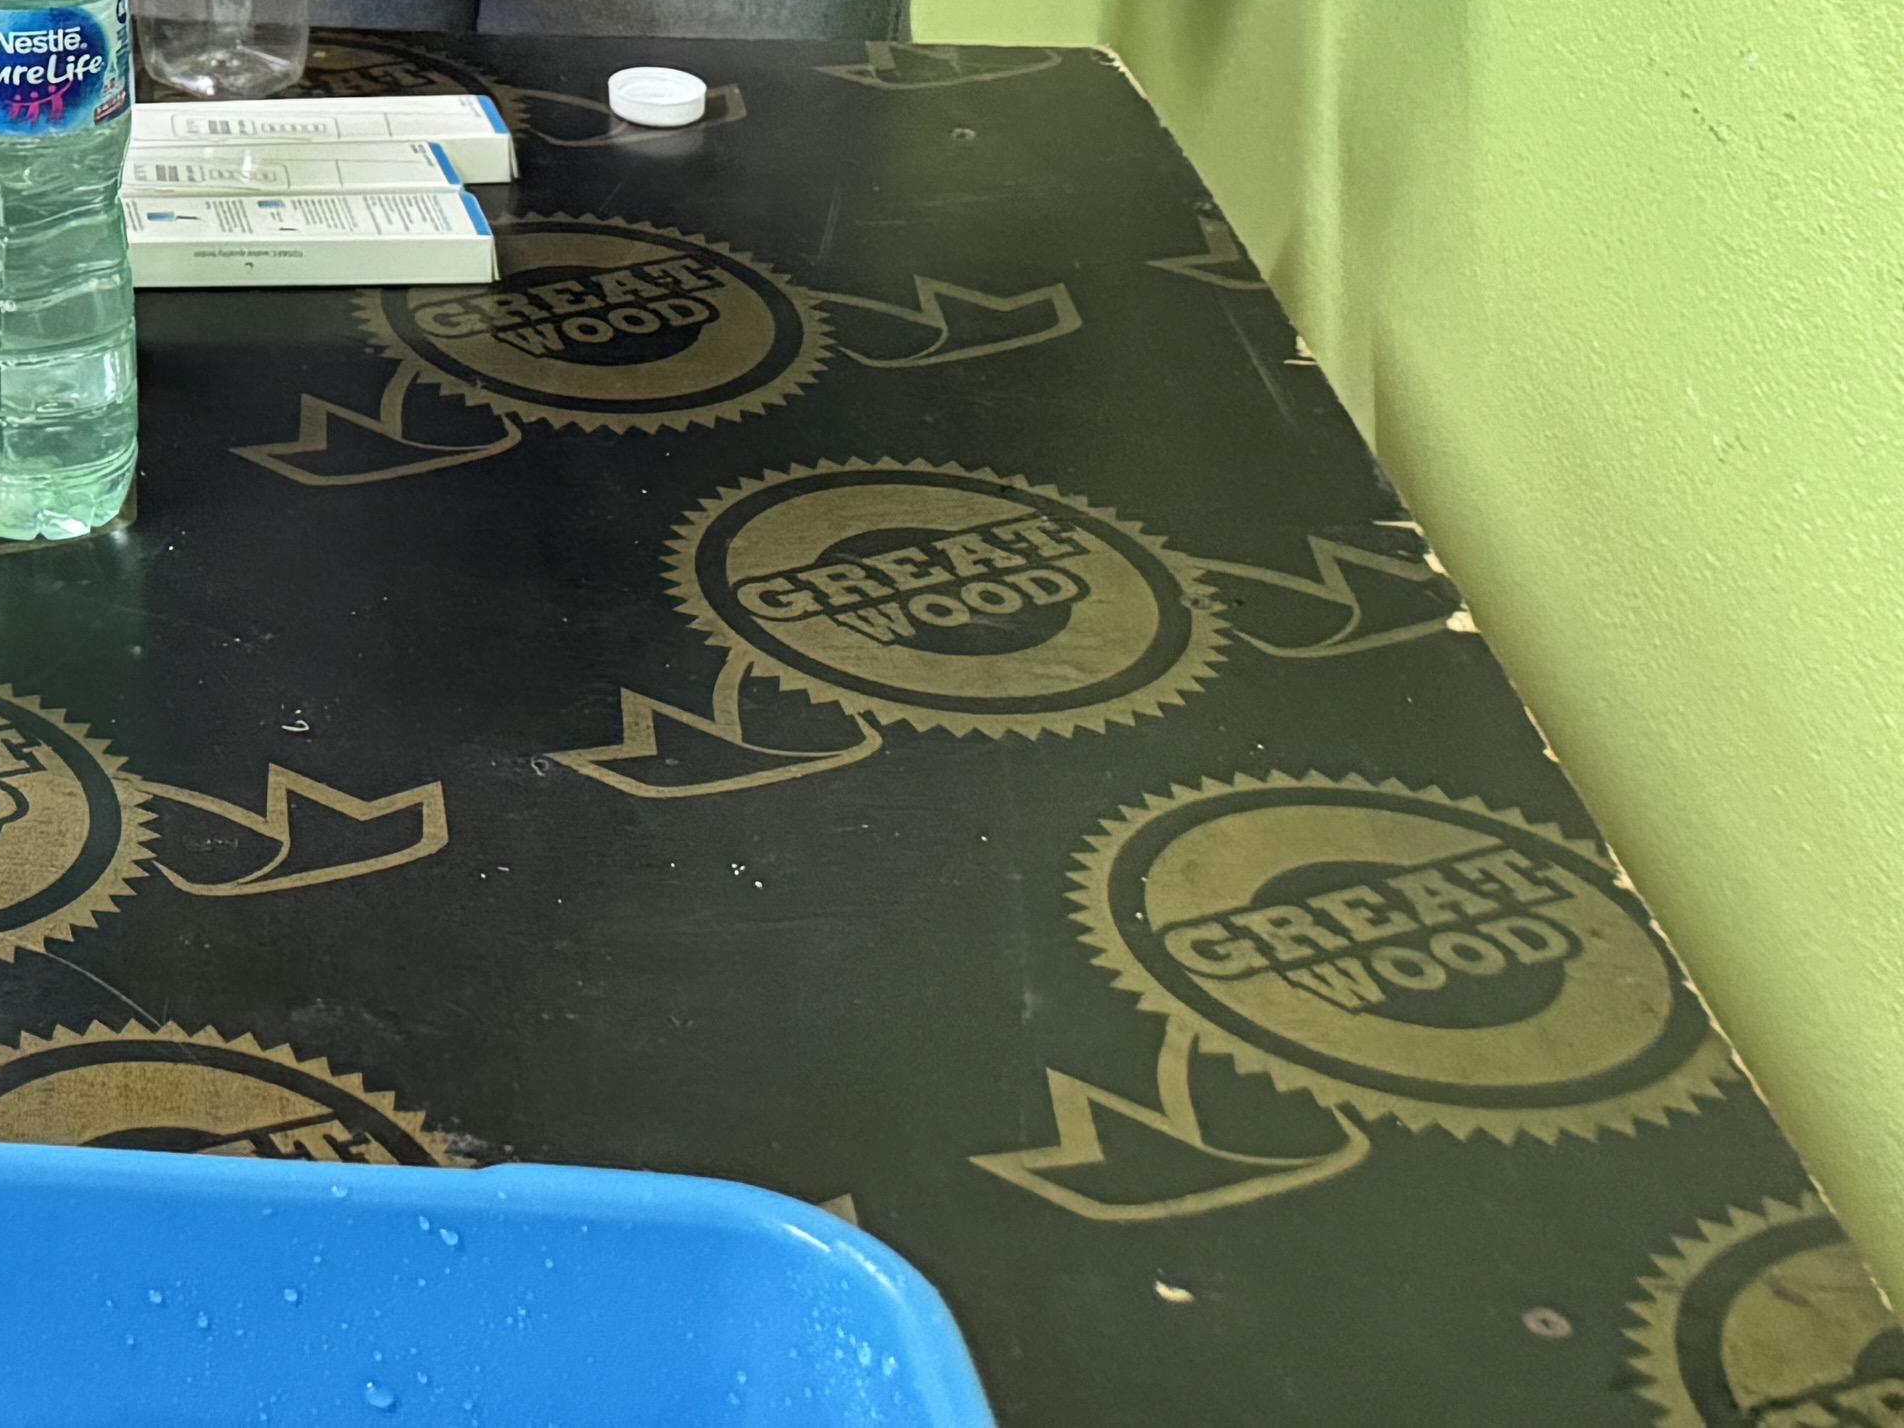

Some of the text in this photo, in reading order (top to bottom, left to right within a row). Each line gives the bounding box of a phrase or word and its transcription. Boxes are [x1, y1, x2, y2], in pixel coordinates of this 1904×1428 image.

[414, 256, 715, 338] GREAT
[495, 298, 710, 356] WOOD
[737, 517, 1078, 620] GREAT
[836, 568, 1080, 642] WOOD
[1164, 848, 1555, 978] GREAT
[1286, 915, 1571, 1011] WOOD
